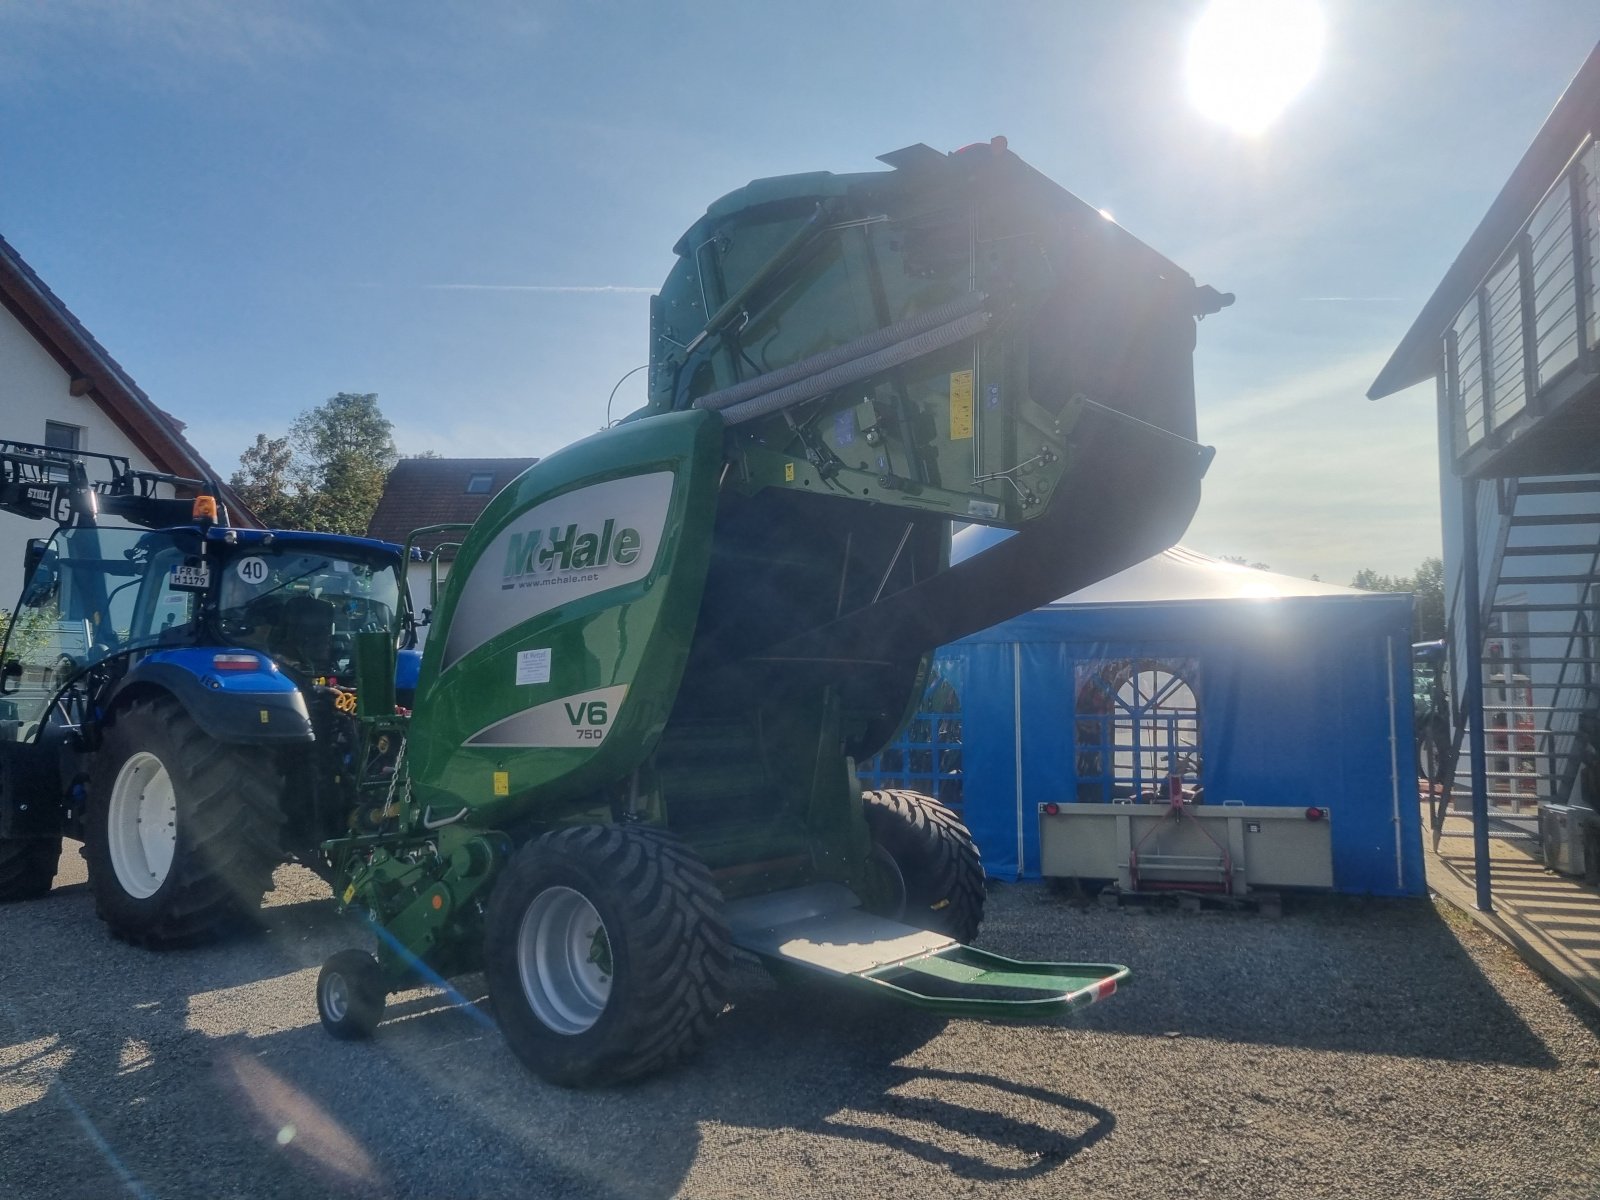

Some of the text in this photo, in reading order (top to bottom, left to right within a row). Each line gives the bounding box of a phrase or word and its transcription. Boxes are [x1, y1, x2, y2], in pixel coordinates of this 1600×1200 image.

[27, 488, 50, 501] STOLL
[504, 518, 641, 577] McHale
[180, 567, 192, 576] FR
[242, 561, 262, 579] 40
[518, 573, 600, 589] www.mchale.net
[564, 701, 608, 726] V6
[576, 729, 603, 739] 750
